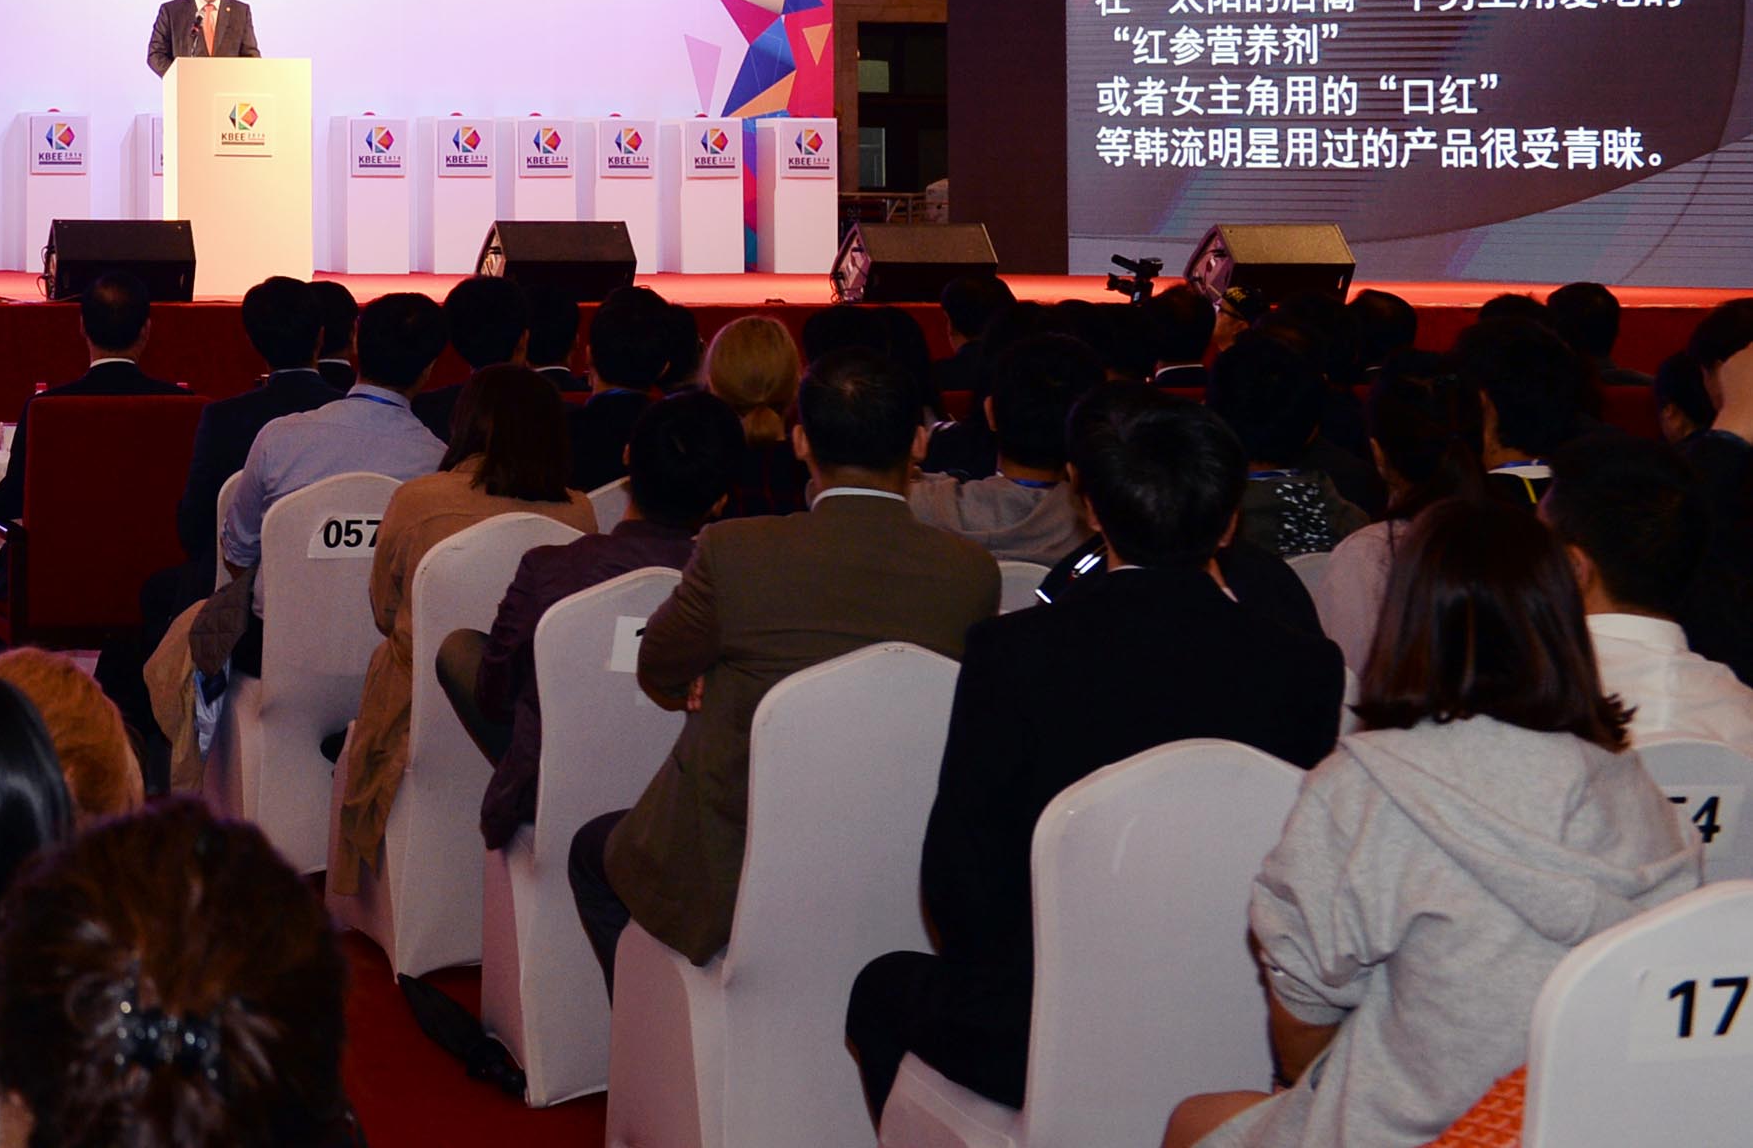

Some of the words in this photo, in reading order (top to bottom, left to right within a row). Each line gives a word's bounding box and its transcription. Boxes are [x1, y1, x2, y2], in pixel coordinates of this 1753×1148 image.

[221, 132, 245, 141] KBEE
[38, 152, 63, 160] KBEE
[358, 155, 382, 164] KBEE
[446, 155, 469, 163] KBEE
[526, 156, 550, 164] KBEE
[608, 156, 631, 164] KBEE
[694, 156, 717, 164] KBEE
[788, 157, 812, 165] KBEE
[323, 519, 383, 548] 057
[1668, 975, 1750, 1039] 17
